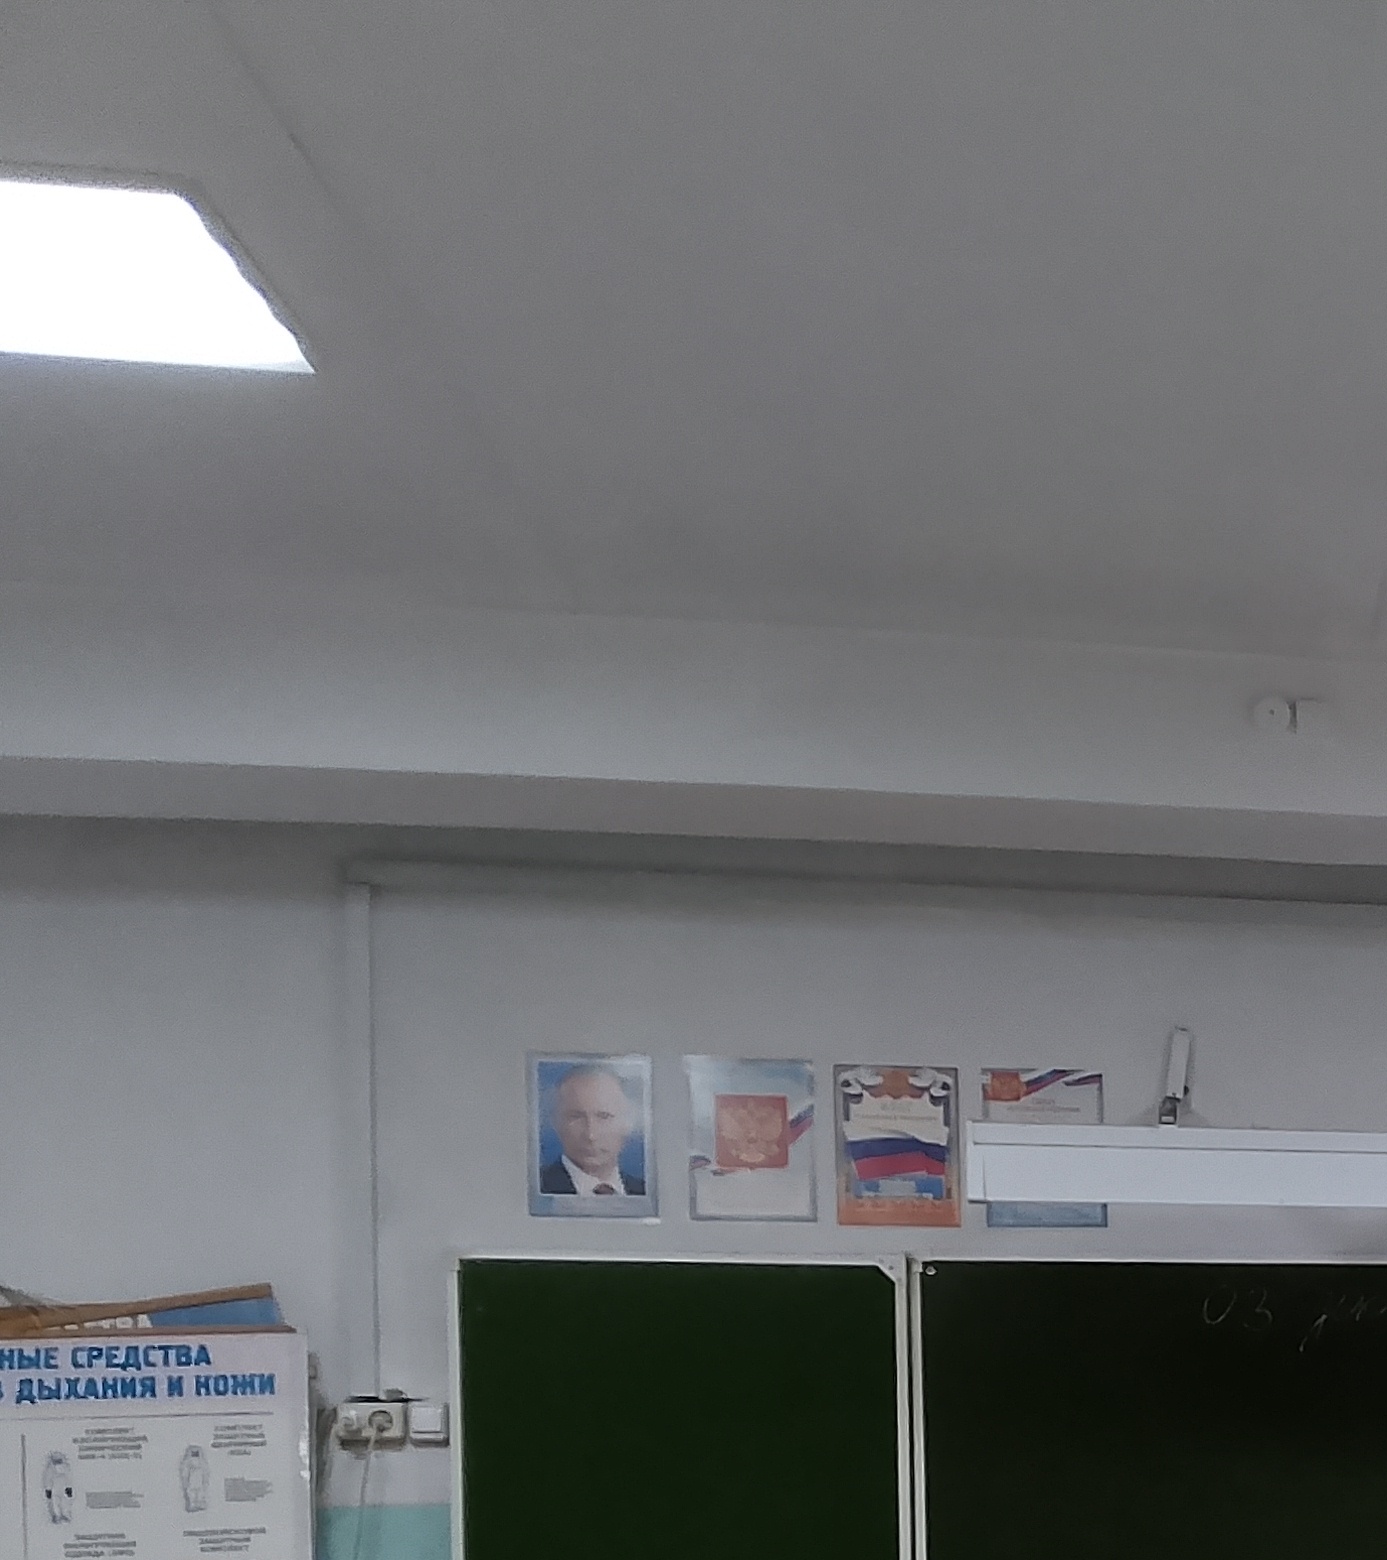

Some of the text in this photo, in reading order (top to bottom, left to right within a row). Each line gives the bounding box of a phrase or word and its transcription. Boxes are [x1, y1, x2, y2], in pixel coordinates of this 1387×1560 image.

[71, 1343, 213, 1372] СРЕДСТВА
[15, 1375, 158, 1405] ДЫХАНИЯ
[167, 1375, 184, 1398] И
